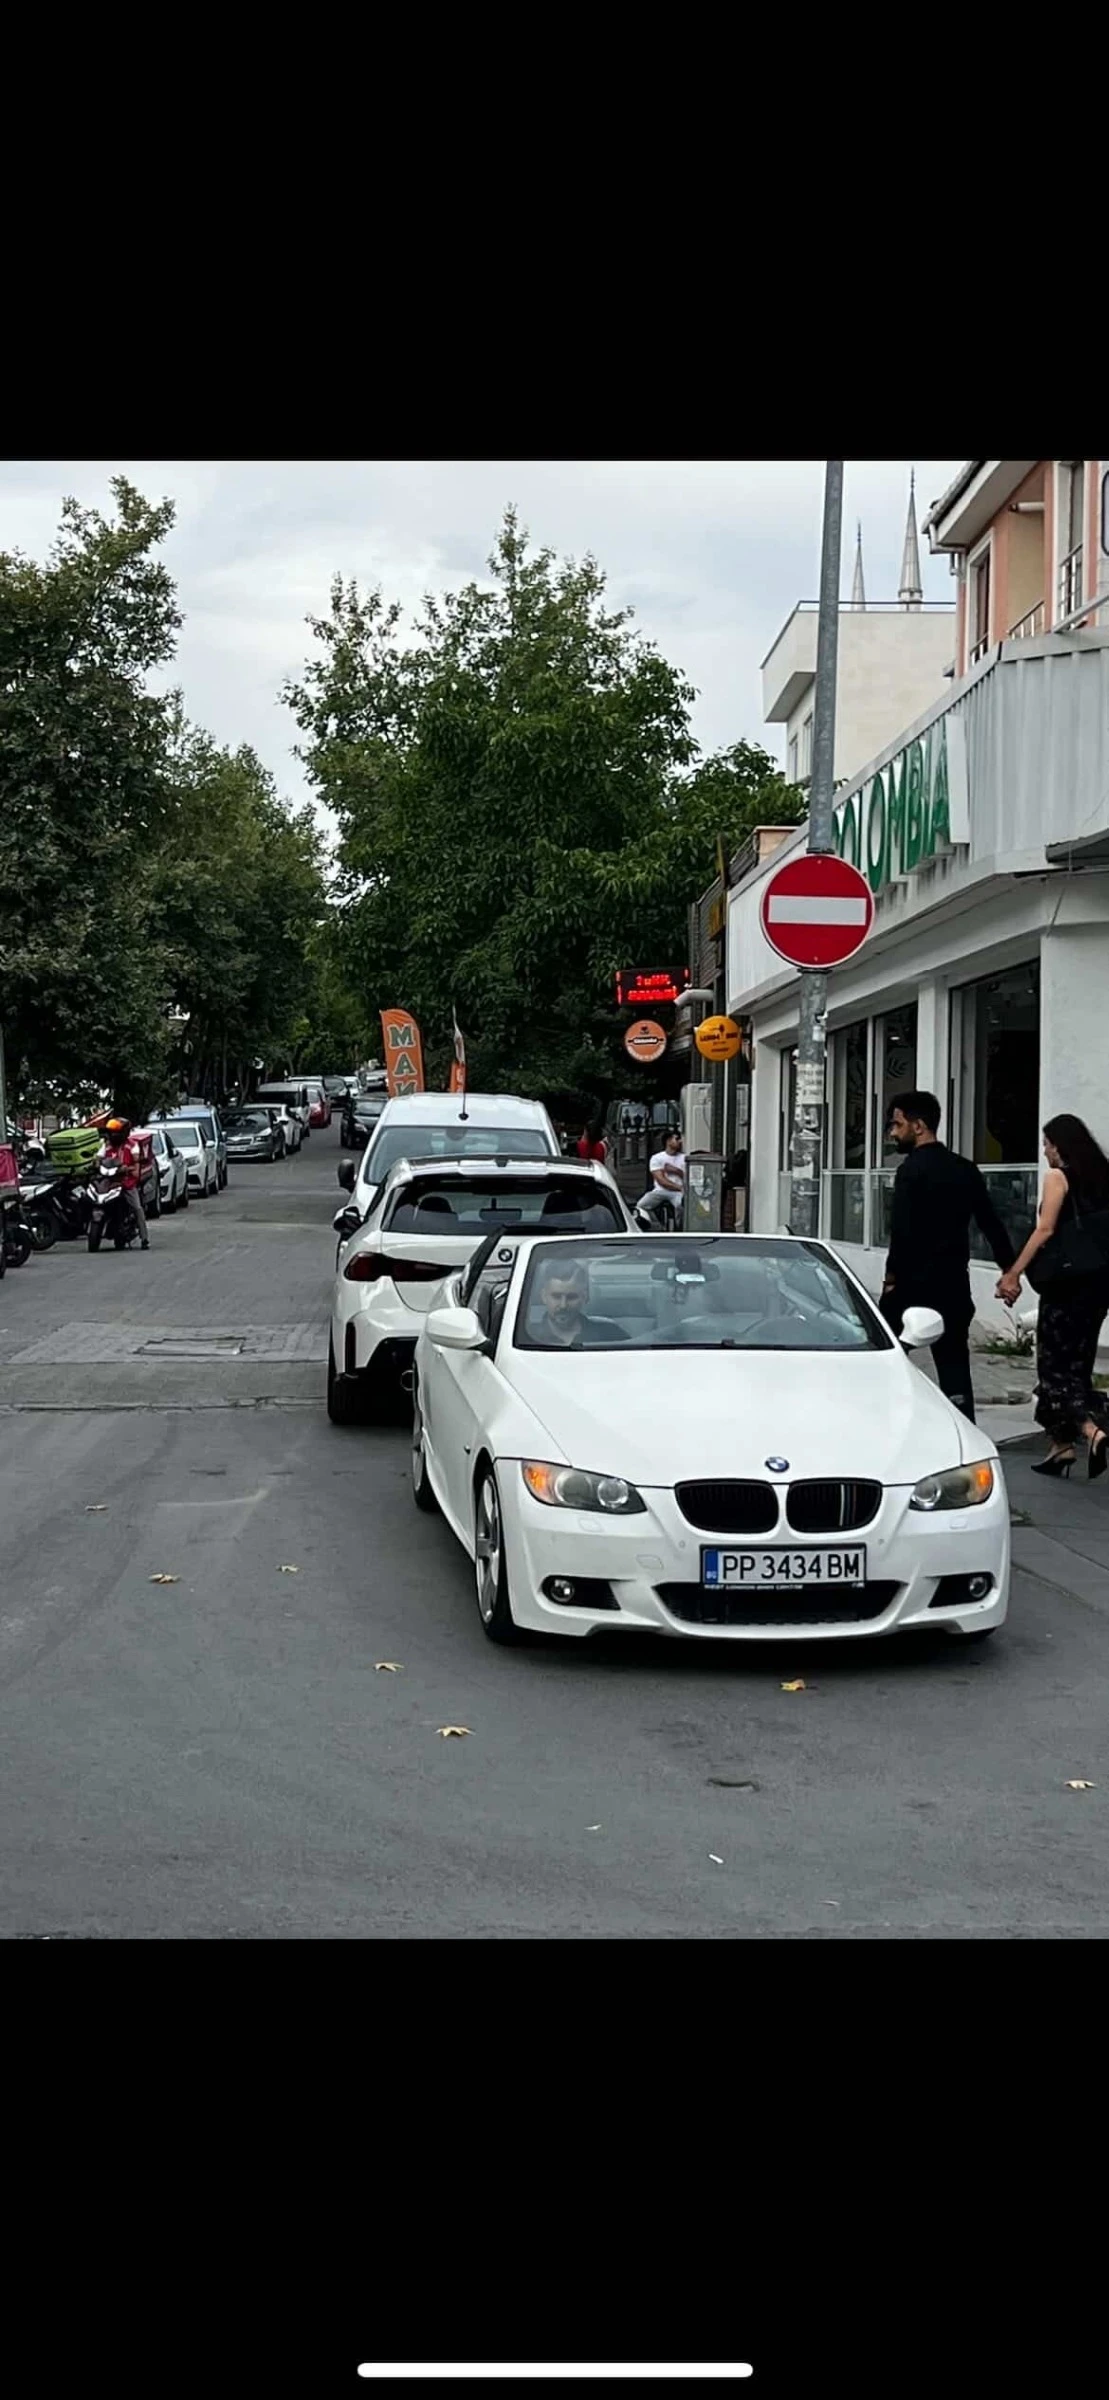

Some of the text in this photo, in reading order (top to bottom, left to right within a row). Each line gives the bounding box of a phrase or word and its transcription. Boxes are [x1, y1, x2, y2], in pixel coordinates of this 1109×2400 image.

[833, 714, 950, 893] OLOMBIA
[722, 1553, 859, 1580] PP 3434 BM
